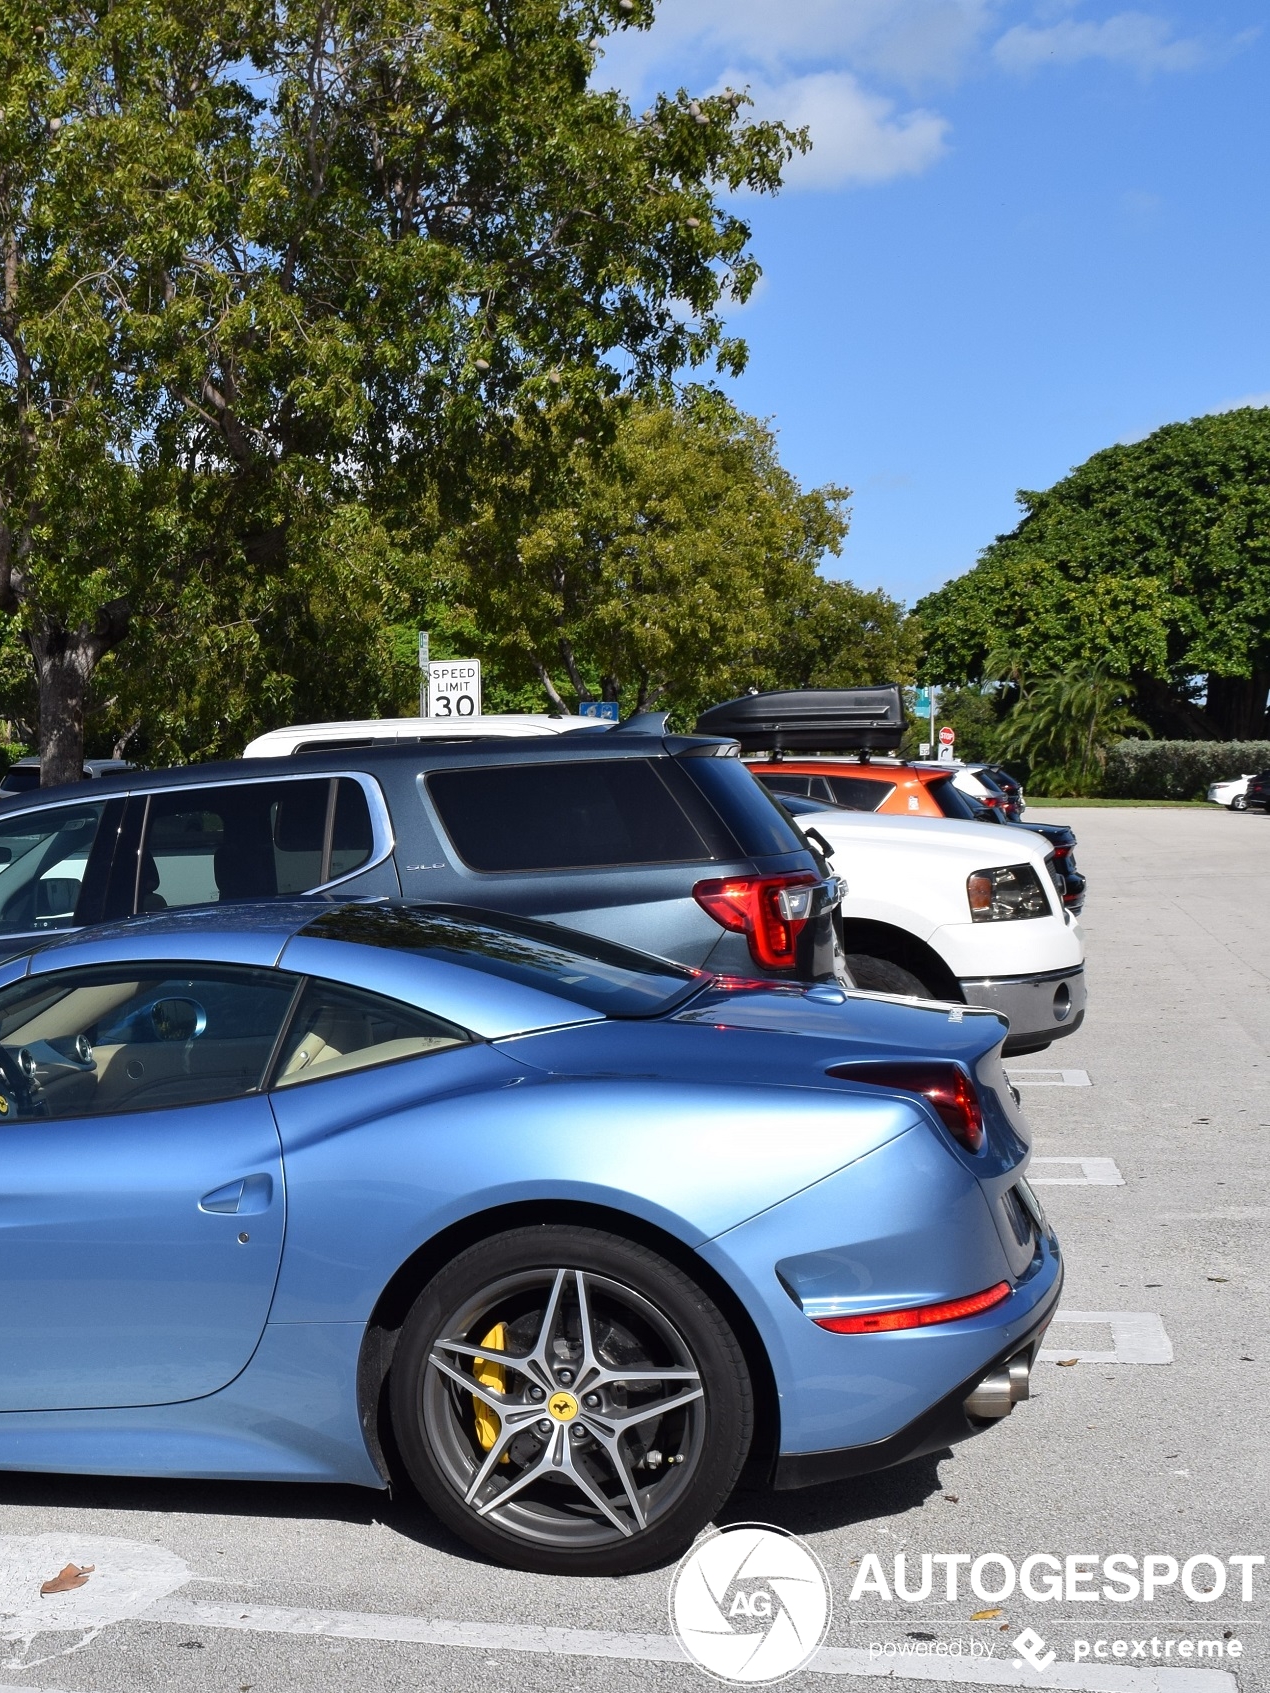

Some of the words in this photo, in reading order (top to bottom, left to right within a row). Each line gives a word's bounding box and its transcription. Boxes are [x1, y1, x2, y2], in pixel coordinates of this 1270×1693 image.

[433, 668, 476, 680] SPEED
[437, 681, 471, 692] LIMIT
[434, 694, 475, 717] 30
[940, 732, 953, 740] STOP
